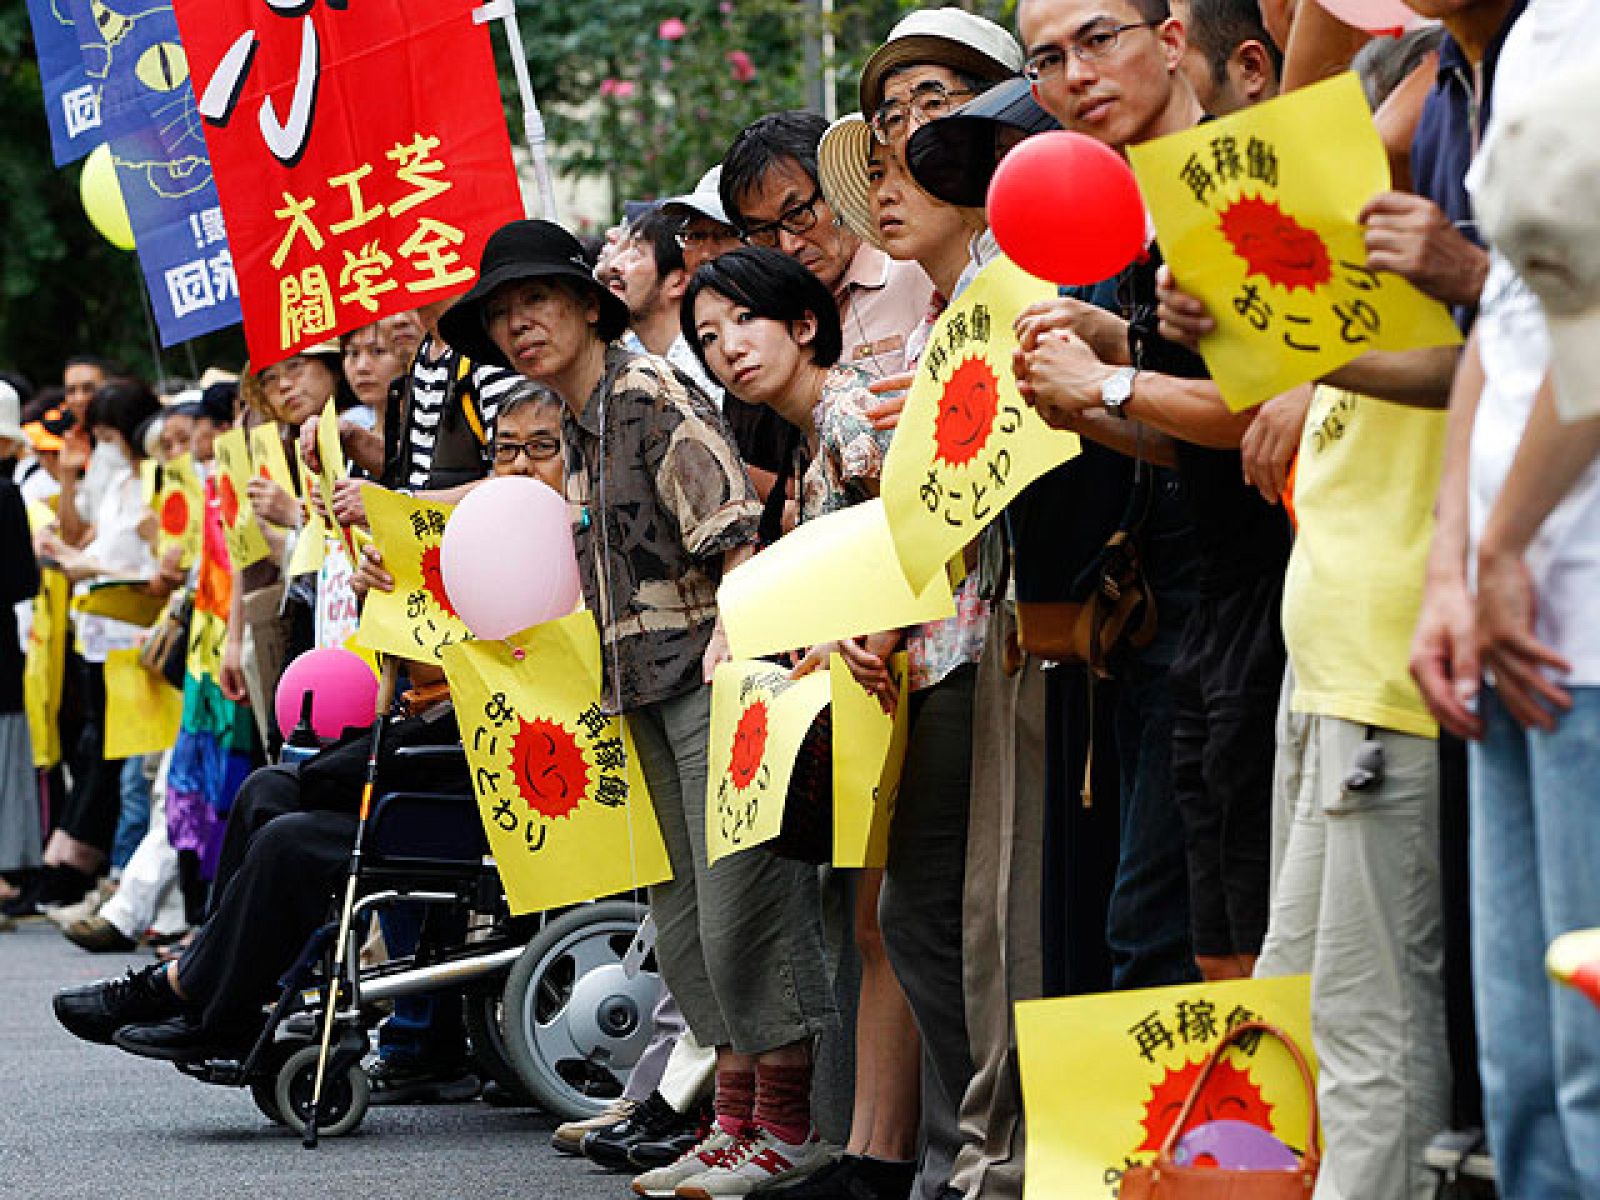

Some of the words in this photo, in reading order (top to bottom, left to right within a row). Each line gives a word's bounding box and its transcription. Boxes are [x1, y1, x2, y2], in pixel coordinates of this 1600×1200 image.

[1179, 134, 1278, 207] 再稼働
[924, 303, 991, 383] 再稼働
[919, 405, 1022, 527] おことわり
[474, 692, 547, 853] おことわり
[576, 701, 630, 808] 再稼働
